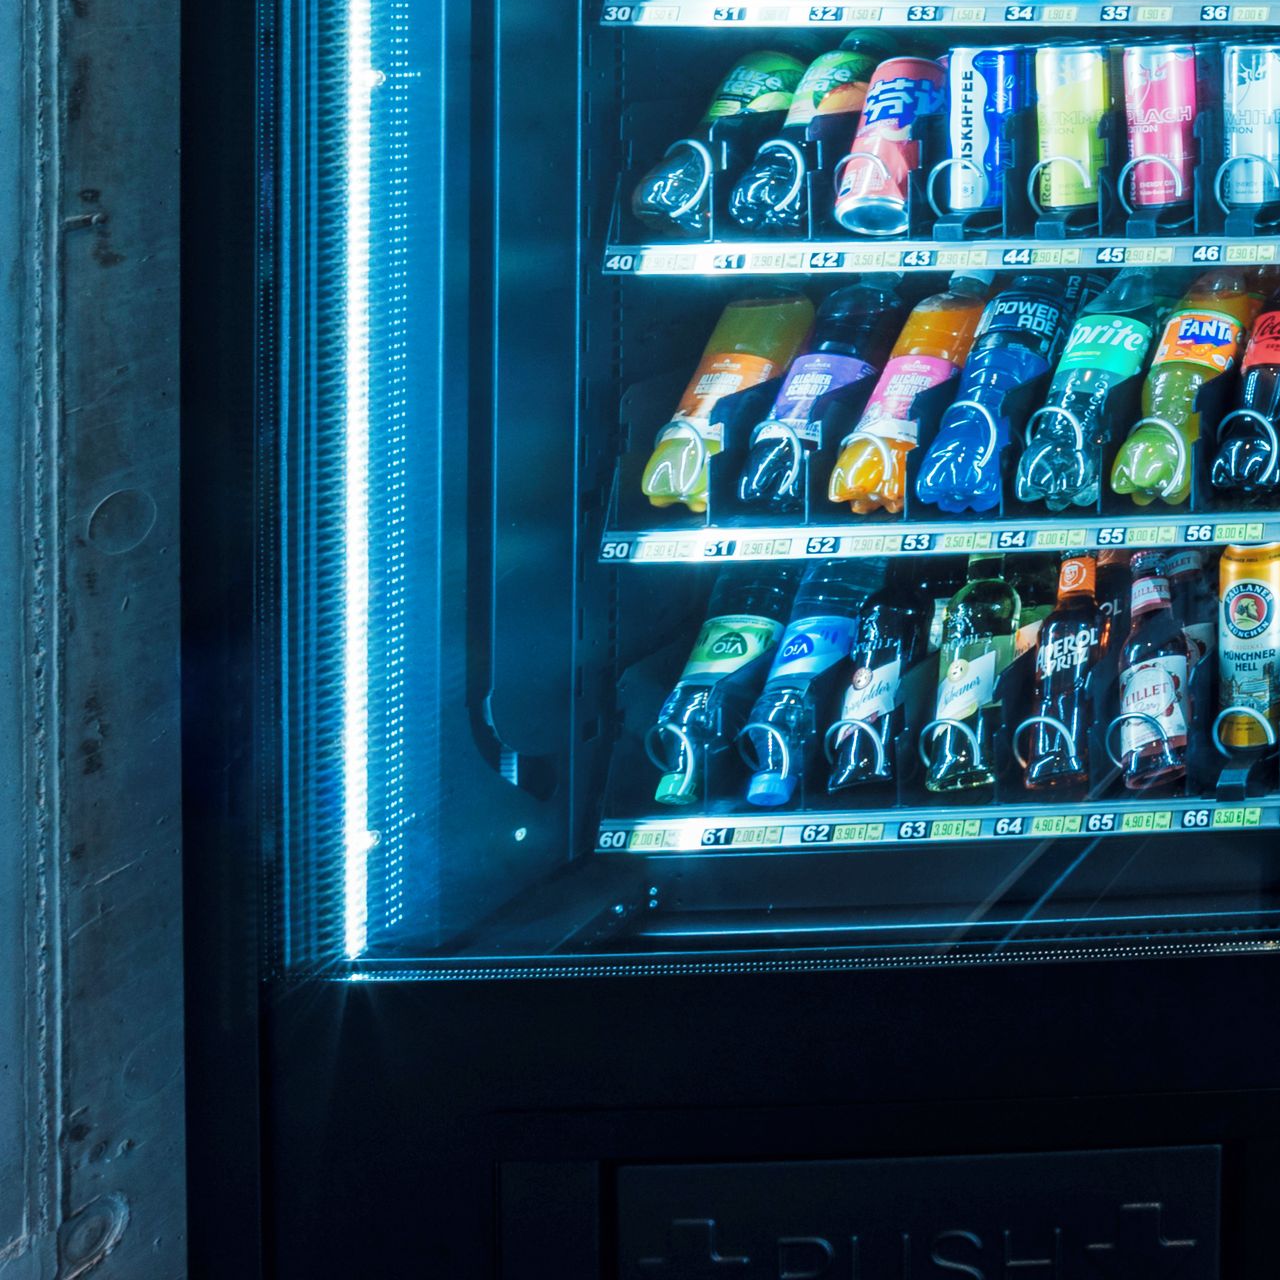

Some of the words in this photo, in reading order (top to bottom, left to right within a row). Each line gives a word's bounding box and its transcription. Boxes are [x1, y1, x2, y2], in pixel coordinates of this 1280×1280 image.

[605, 8, 632, 21] 30
[715, 8, 741, 21] 31
[810, 7, 838, 21] 32
[909, 7, 935, 20] 33
[1007, 6, 1033, 20] 34
[1102, 6, 1128, 20] 35
[1202, 6, 1227, 20] 36
[1128, 105, 1193, 126] PEACH
[811, 253, 837, 268] 42
[904, 251, 931, 266] 43
[1004, 249, 1031, 264] 44
[1098, 247, 1124, 262] 45
[1194, 246, 1219, 260] 46
[607, 255, 633, 270] 40
[995, 300, 1059, 324] POWER
[1017, 316, 1056, 335] ADE
[1178, 317, 1232, 342] FANTA
[1065, 319, 1144, 353] Sprite
[1000, 531, 1026, 548] 54
[1099, 528, 1124, 544] 55
[1186, 525, 1212, 541] 56
[602, 542, 629, 558] 50
[705, 541, 730, 556] 51
[808, 537, 834, 553] 52
[904, 534, 930, 550] 53
[1225, 582, 1274, 605] PAULANER
[1226, 621, 1270, 639] MÜNCHEN
[1036, 627, 1099, 673] APEROL
[1223, 648, 1276, 662] MÜNCHNER
[1040, 648, 1089, 681] SPRITZ
[1235, 661, 1258, 672] HELL
[1125, 681, 1169, 707] LILLET
[997, 818, 1022, 835] 64
[1088, 814, 1115, 830] 65
[1184, 811, 1209, 826] 66
[703, 829, 727, 845] 61
[804, 825, 829, 841] 62
[900, 822, 926, 838] 63
[600, 830, 626, 847] 60
